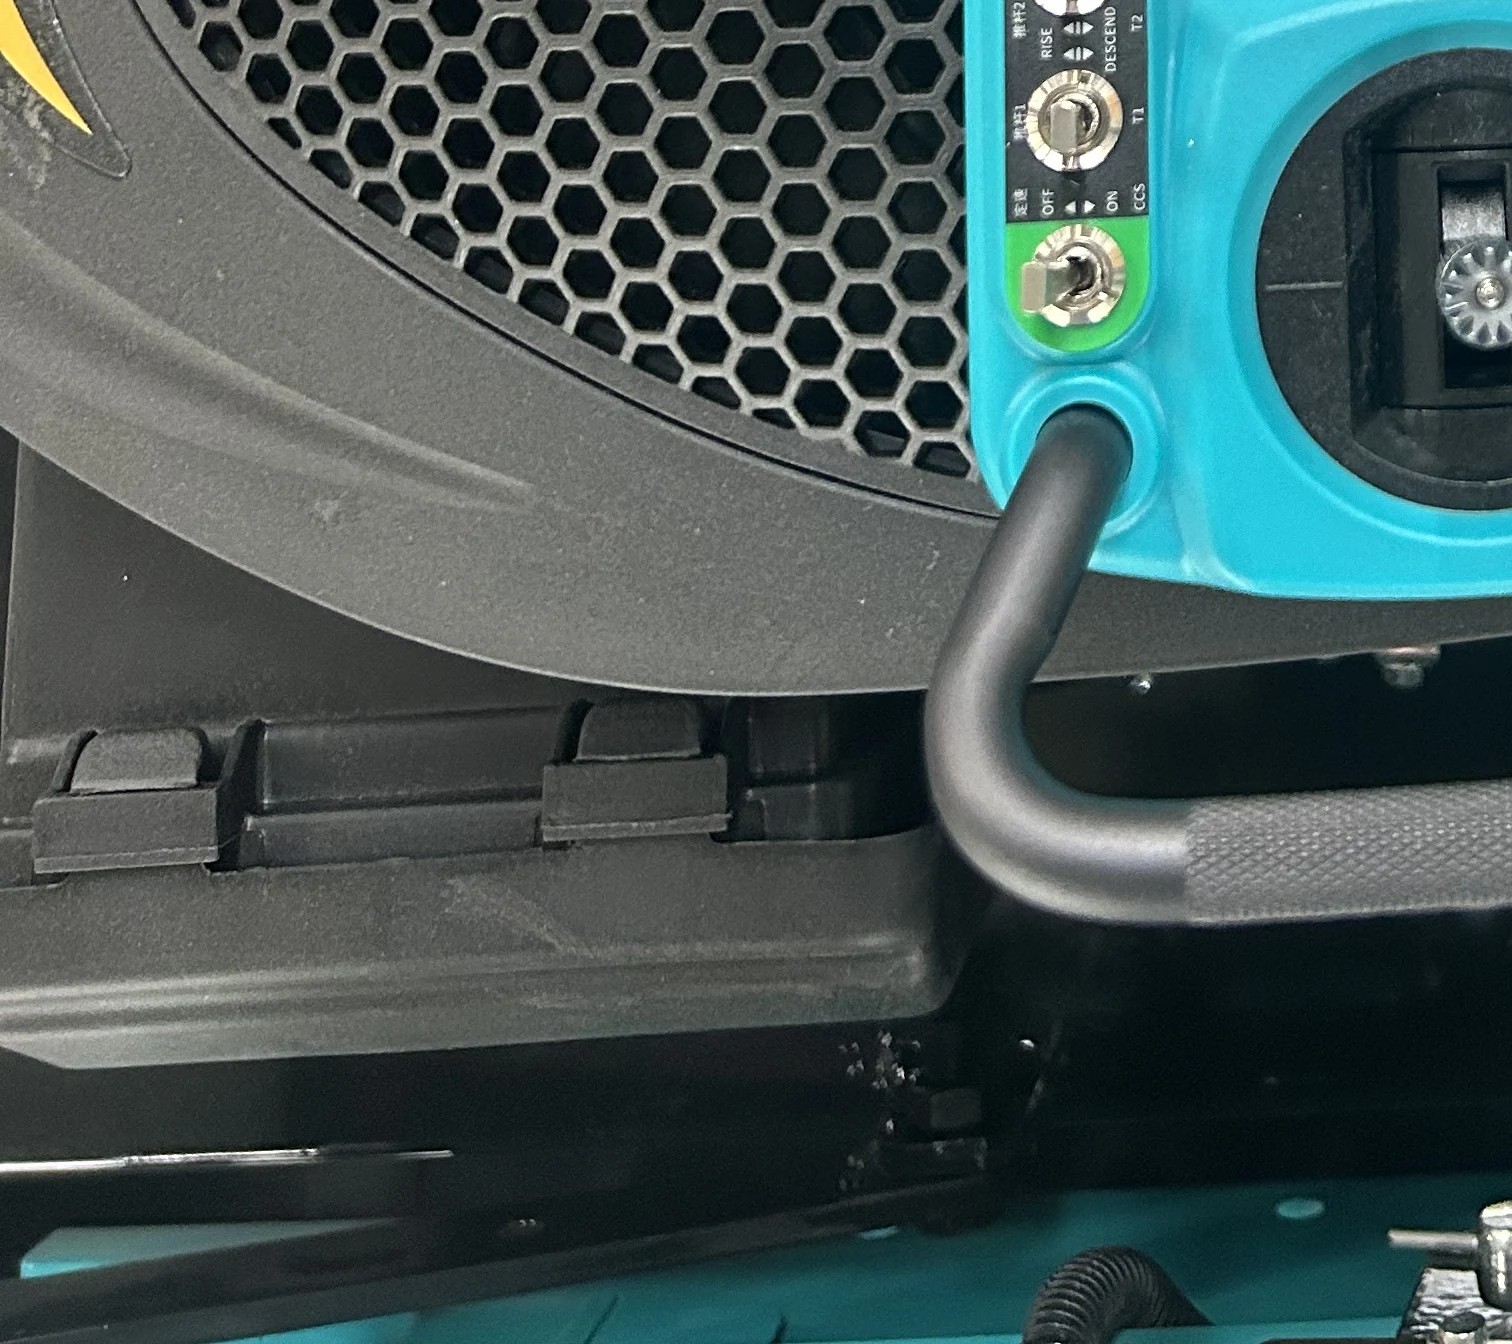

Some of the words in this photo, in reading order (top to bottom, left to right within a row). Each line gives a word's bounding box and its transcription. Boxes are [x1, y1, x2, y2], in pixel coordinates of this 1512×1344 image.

[1012, 2, 1027, 39] 推杆2
[1132, 14, 1144, 31] T2
[1041, 27, 1053, 58] RISE
[1104, 6, 1117, 72] DESCEND
[1132, 107, 1144, 124] T1
[1013, 188, 1029, 217] 定速
[1042, 188, 1054, 215] OFF
[1107, 191, 1119, 212] ON
[1134, 183, 1146, 210] CCS
